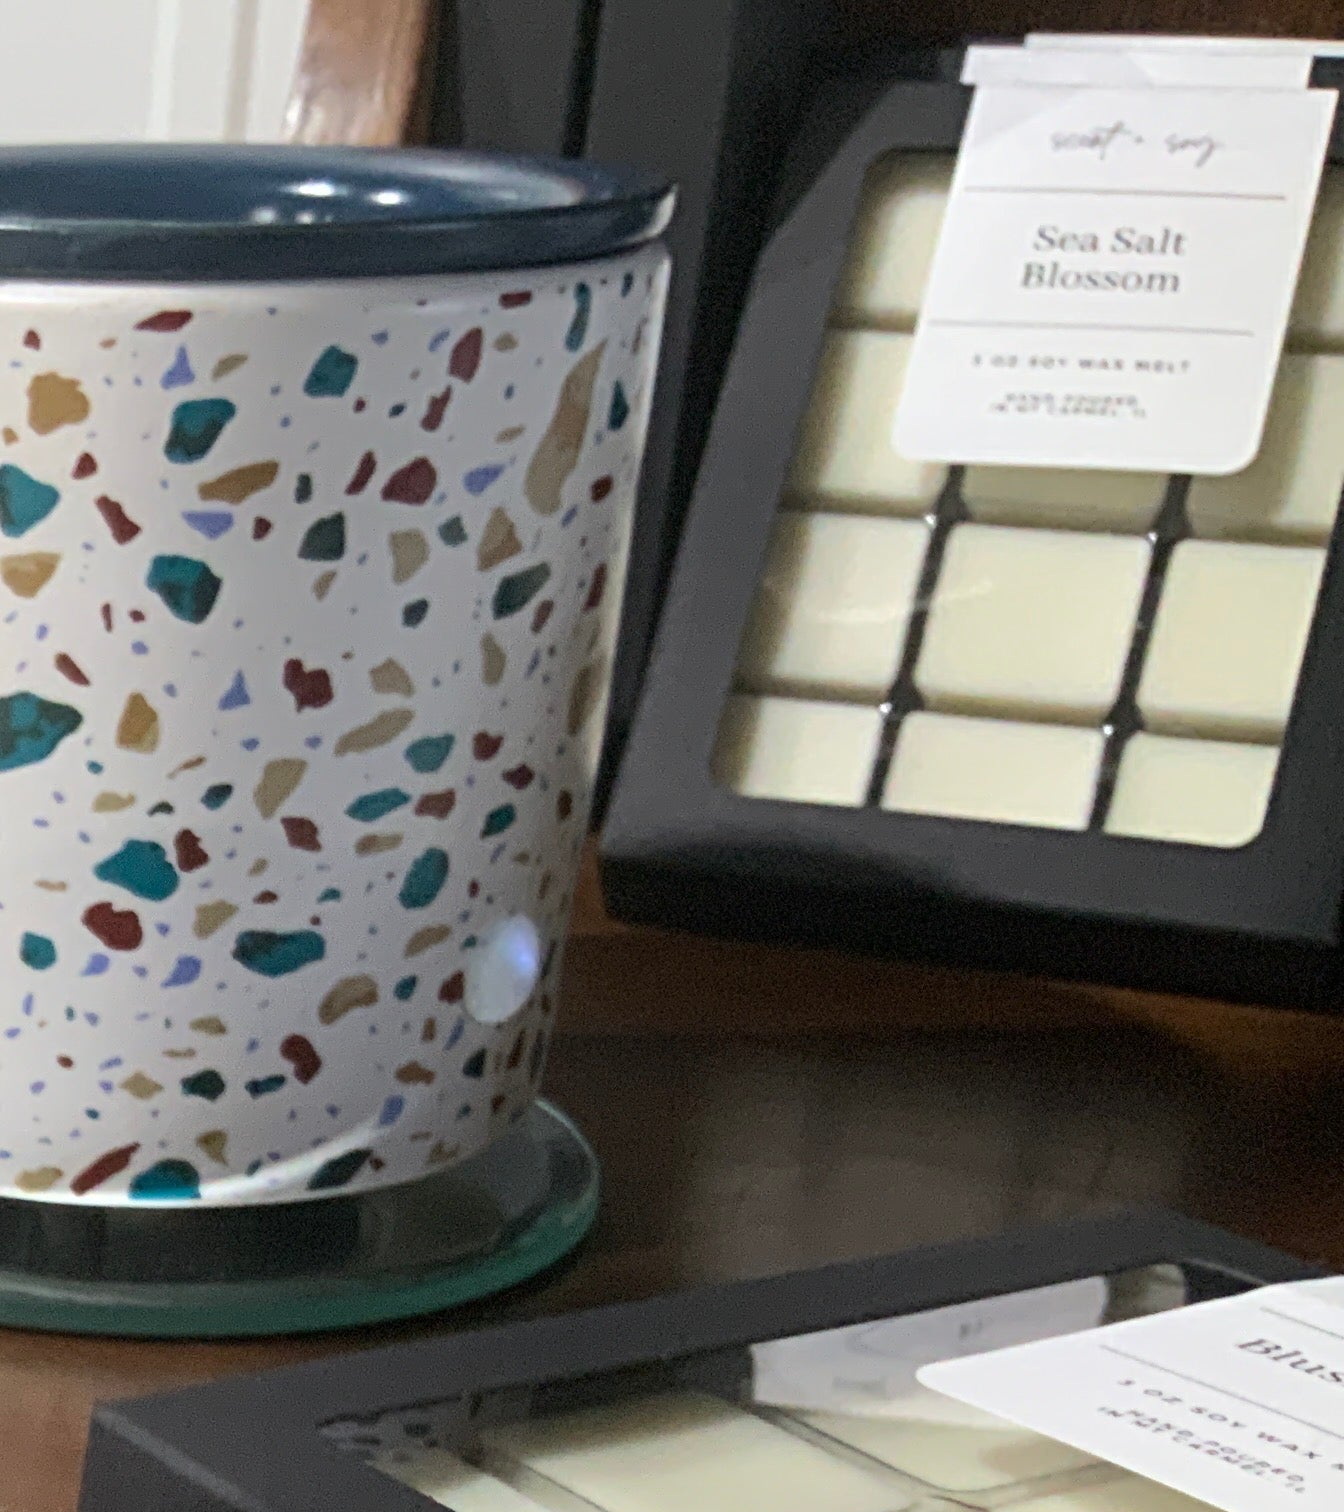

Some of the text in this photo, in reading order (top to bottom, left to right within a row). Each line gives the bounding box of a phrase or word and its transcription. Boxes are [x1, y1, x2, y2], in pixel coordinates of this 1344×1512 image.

[1033, 224, 1186, 256] Sea Salt
[1021, 261, 1181, 293] Blossom
[1257, 1431, 1324, 1460] WAX
